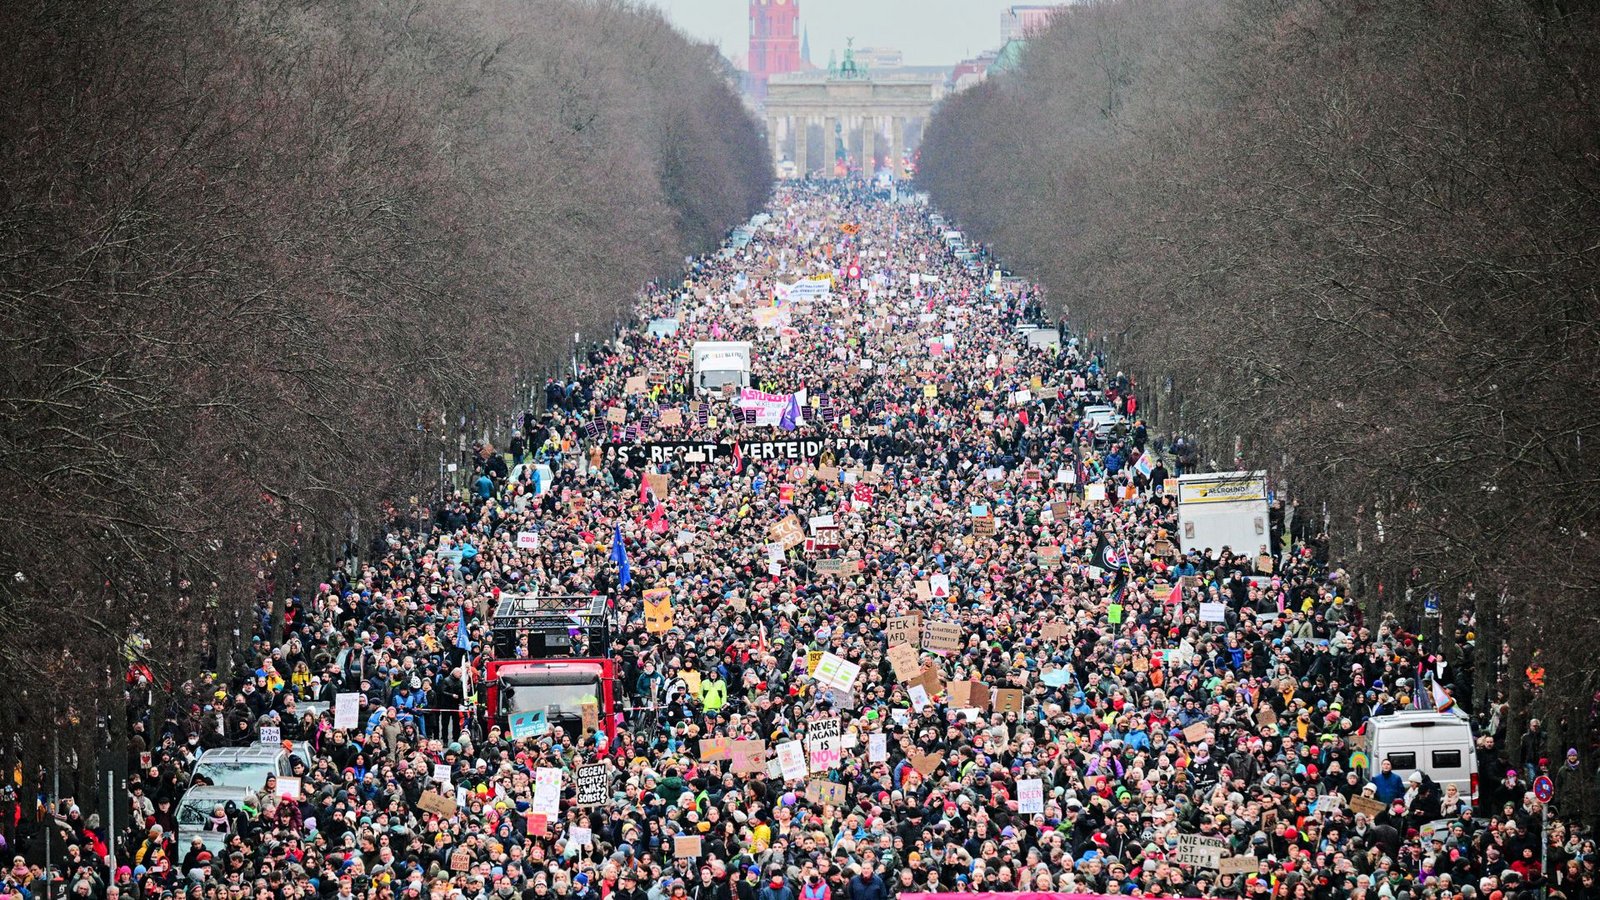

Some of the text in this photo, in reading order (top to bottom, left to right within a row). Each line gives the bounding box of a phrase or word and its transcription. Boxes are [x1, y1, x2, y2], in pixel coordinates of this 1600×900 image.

[817, 530, 839, 538] FCK
[889, 621, 909, 631] FCK
[889, 632, 906, 642] AFD
[810, 720, 838, 731] NEVER
[811, 730, 839, 741] AGAIN
[821, 741, 830, 750] IS
[811, 750, 840, 763] NOW
[578, 766, 605, 777] GEGEN
[577, 775, 607, 786] RECHTS!
[1020, 790, 1042, 800] IDEEN
[1180, 835, 1198, 846] NIE
